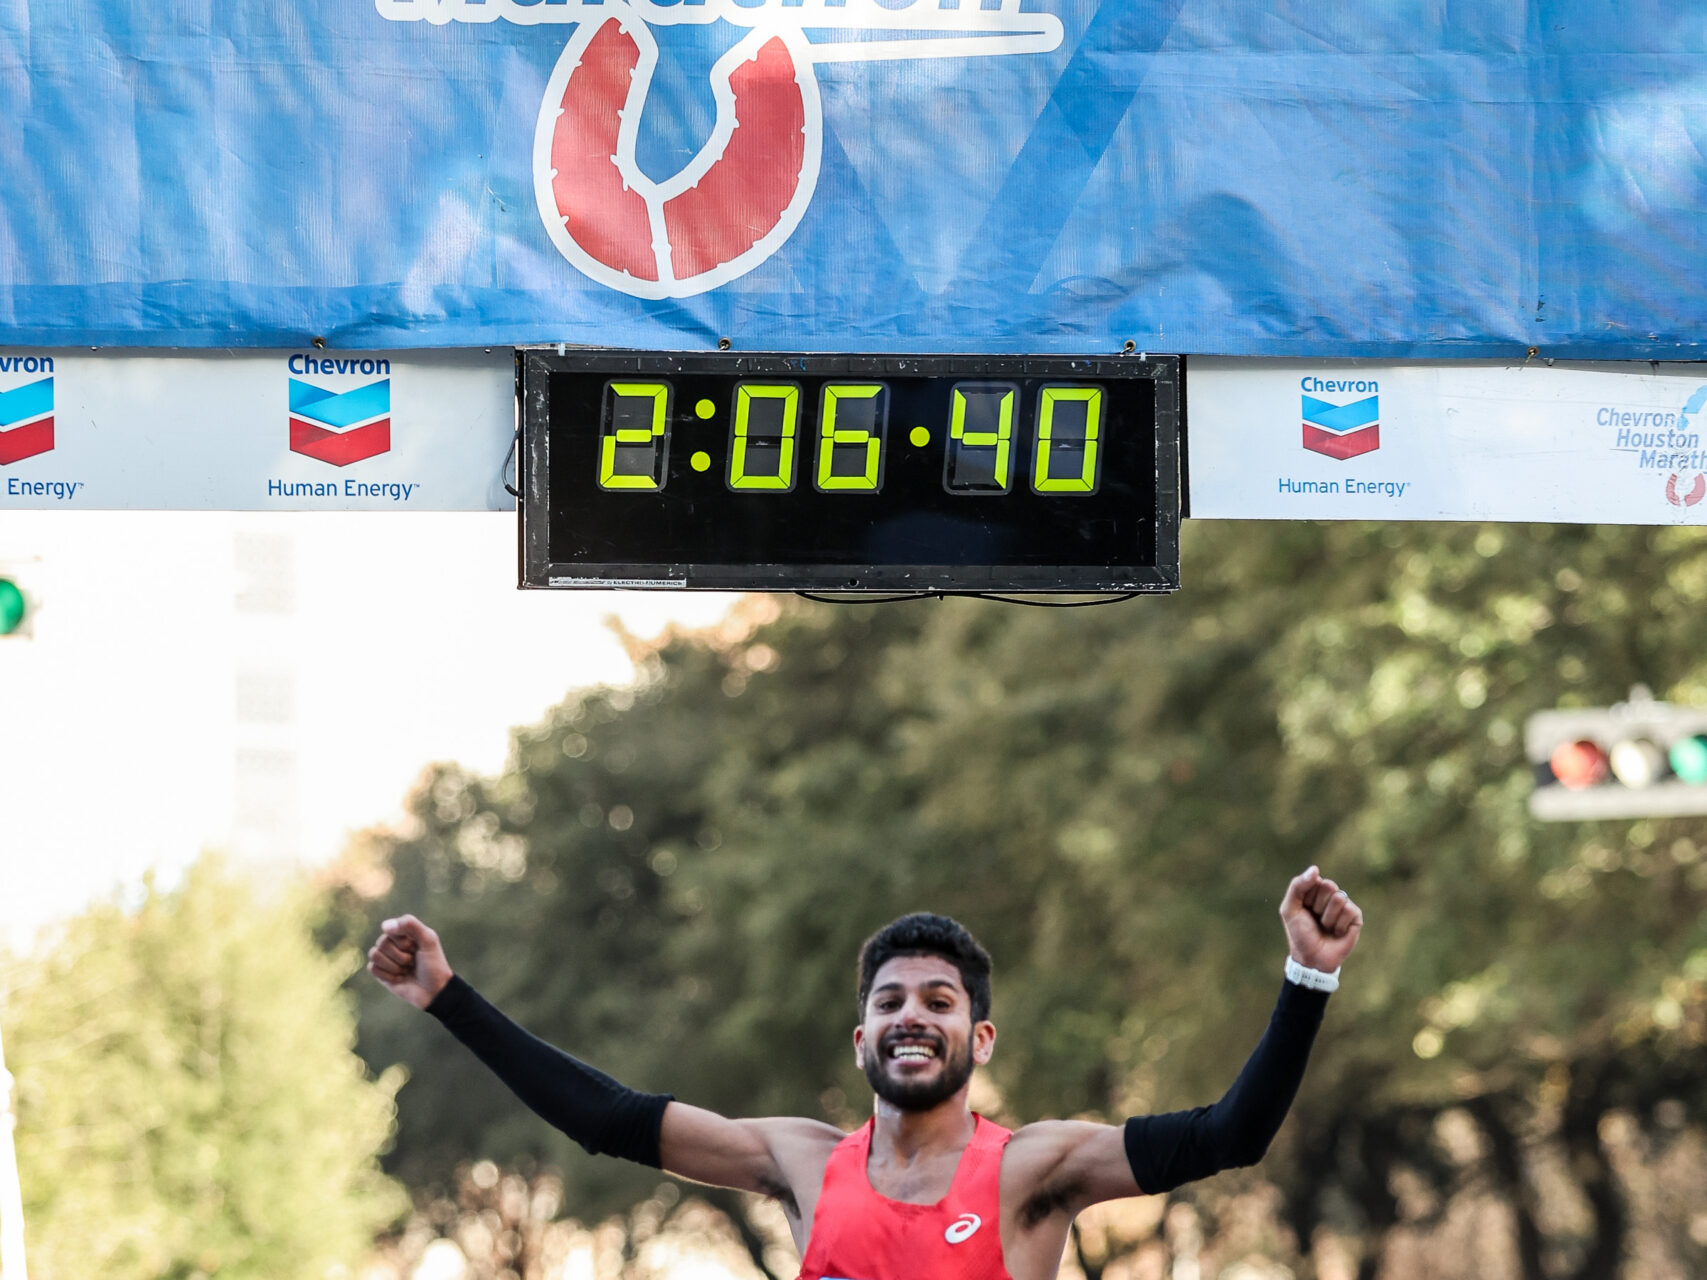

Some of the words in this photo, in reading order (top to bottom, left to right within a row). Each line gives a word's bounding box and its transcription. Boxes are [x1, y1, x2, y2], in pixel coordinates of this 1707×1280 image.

[0, 355, 54, 374] vron
[288, 354, 390, 375] Chevron
[1300, 376, 1379, 393] Chevron
[1596, 407, 1676, 427] Chevron
[1616, 428, 1700, 449] Houston
[1639, 449, 1707, 470] Marath
[268, 479, 338, 497] Human
[1278, 478, 1340, 494] Human
